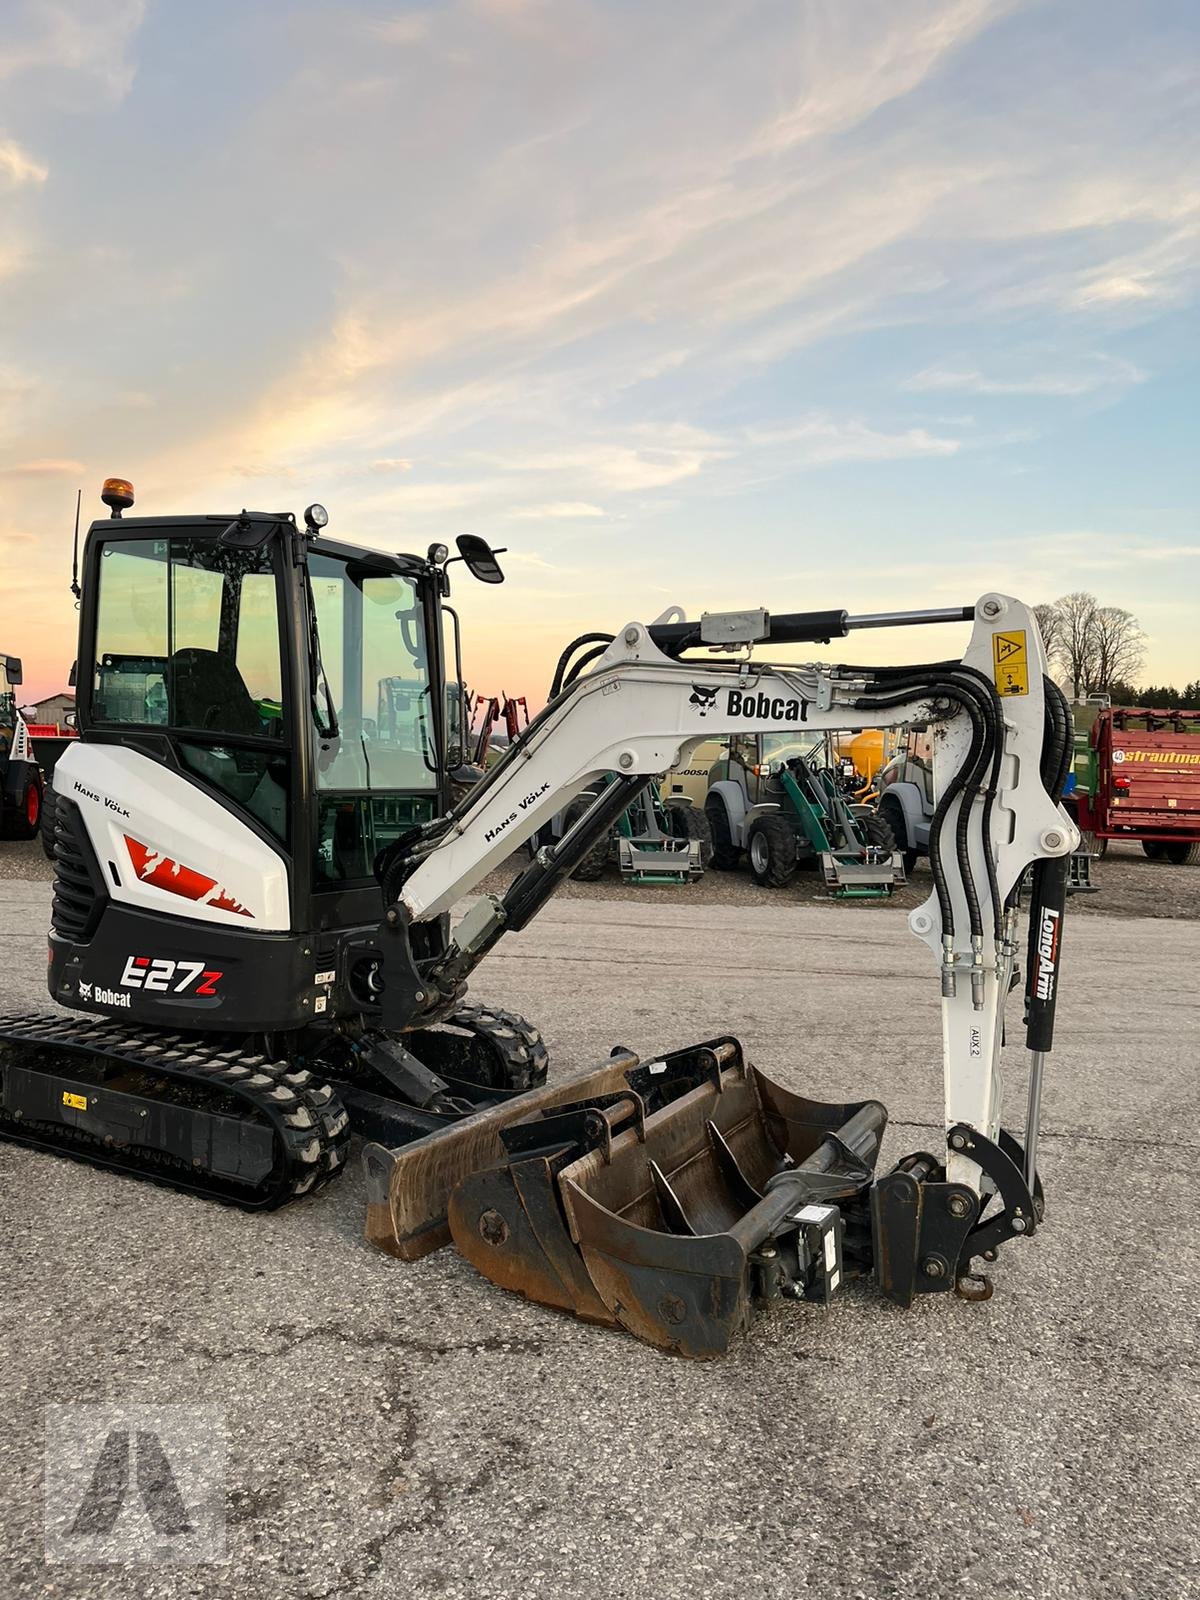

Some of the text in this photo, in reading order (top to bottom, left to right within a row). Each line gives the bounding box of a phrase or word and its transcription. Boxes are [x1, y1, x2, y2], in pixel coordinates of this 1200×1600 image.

[727, 690, 809, 722] Bobcat
[1037, 906, 1060, 1000] LongArm
[94, 986, 131, 1008] Bobcat
[971, 1028, 980, 1048] AUX
